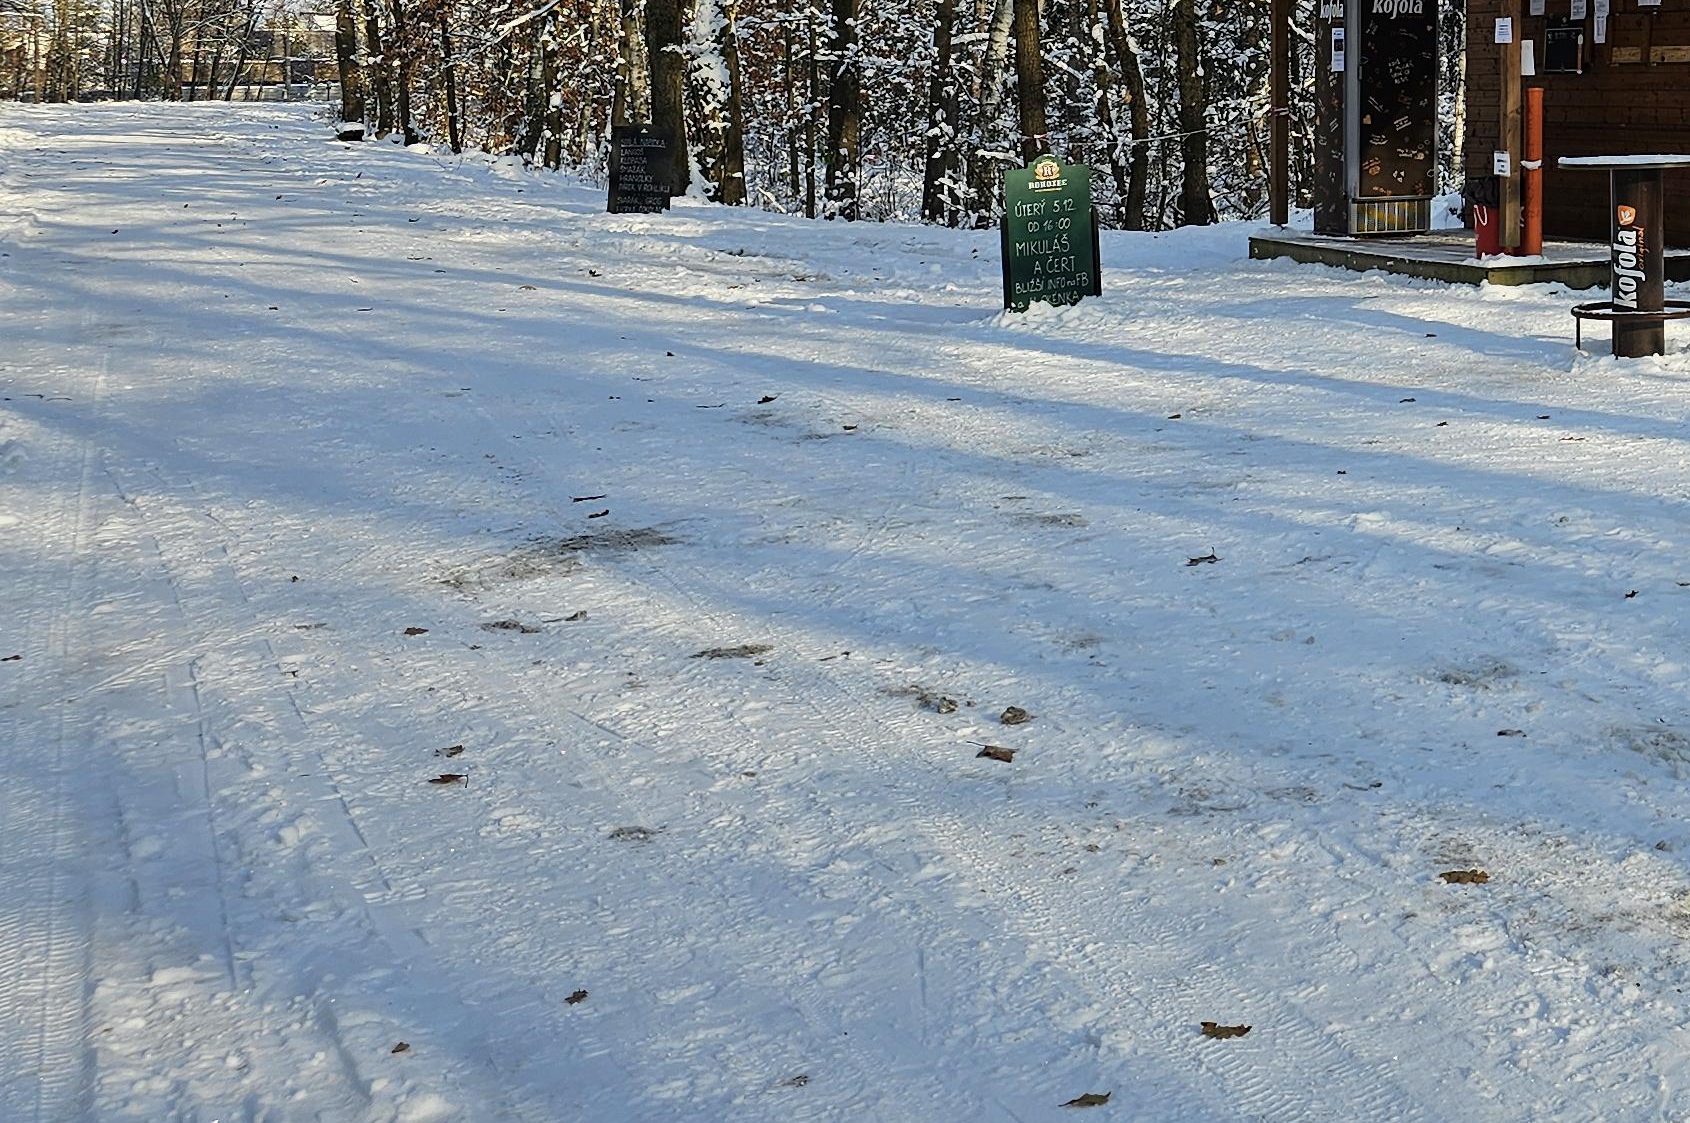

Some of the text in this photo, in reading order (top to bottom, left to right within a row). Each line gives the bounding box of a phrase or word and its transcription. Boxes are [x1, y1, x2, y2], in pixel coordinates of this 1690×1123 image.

[1014, 198, 1046, 217] ÚTERÝ
[1027, 221, 1040, 233] OD
[1015, 233, 1070, 257] MIKULÁŠ
[1033, 255, 1076, 275] A ČERT
[1613, 230, 1646, 309] kofola
[1015, 276, 1045, 294] BLIŽŠÍ
[1076, 272, 1089, 287] FB
